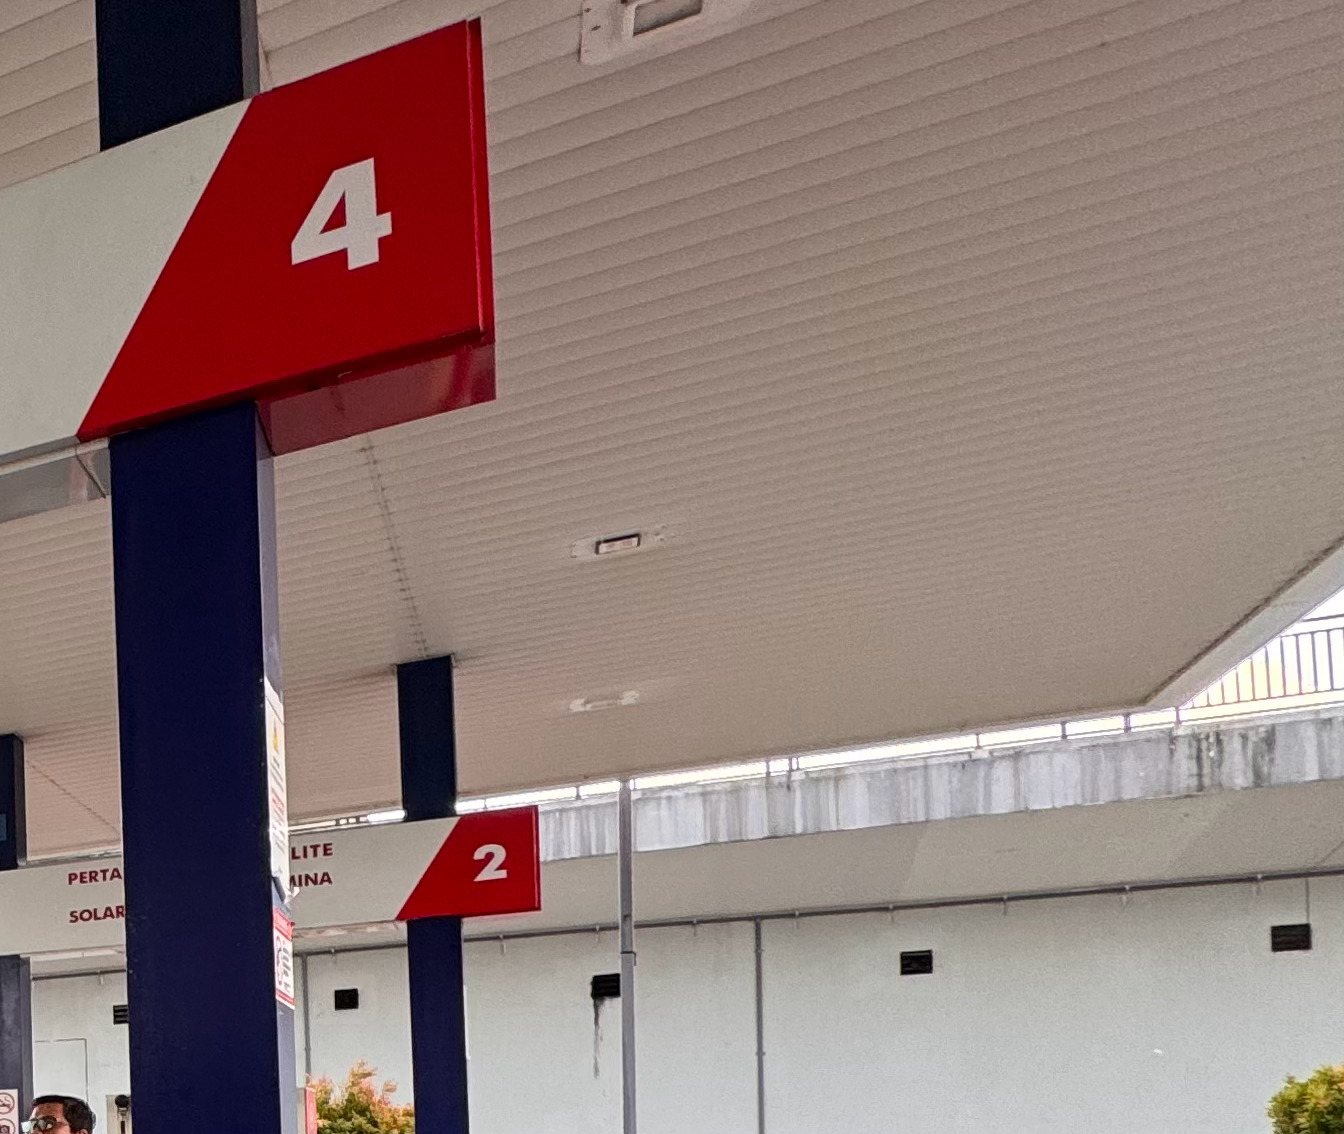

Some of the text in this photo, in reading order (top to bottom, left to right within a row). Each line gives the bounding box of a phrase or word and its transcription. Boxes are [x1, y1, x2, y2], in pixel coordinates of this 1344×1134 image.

[292, 157, 393, 271] 4
[290, 842, 334, 860] LITE
[473, 843, 507, 882] 2
[67, 867, 123, 886] PERTA
[69, 904, 126, 924] SOLAR
